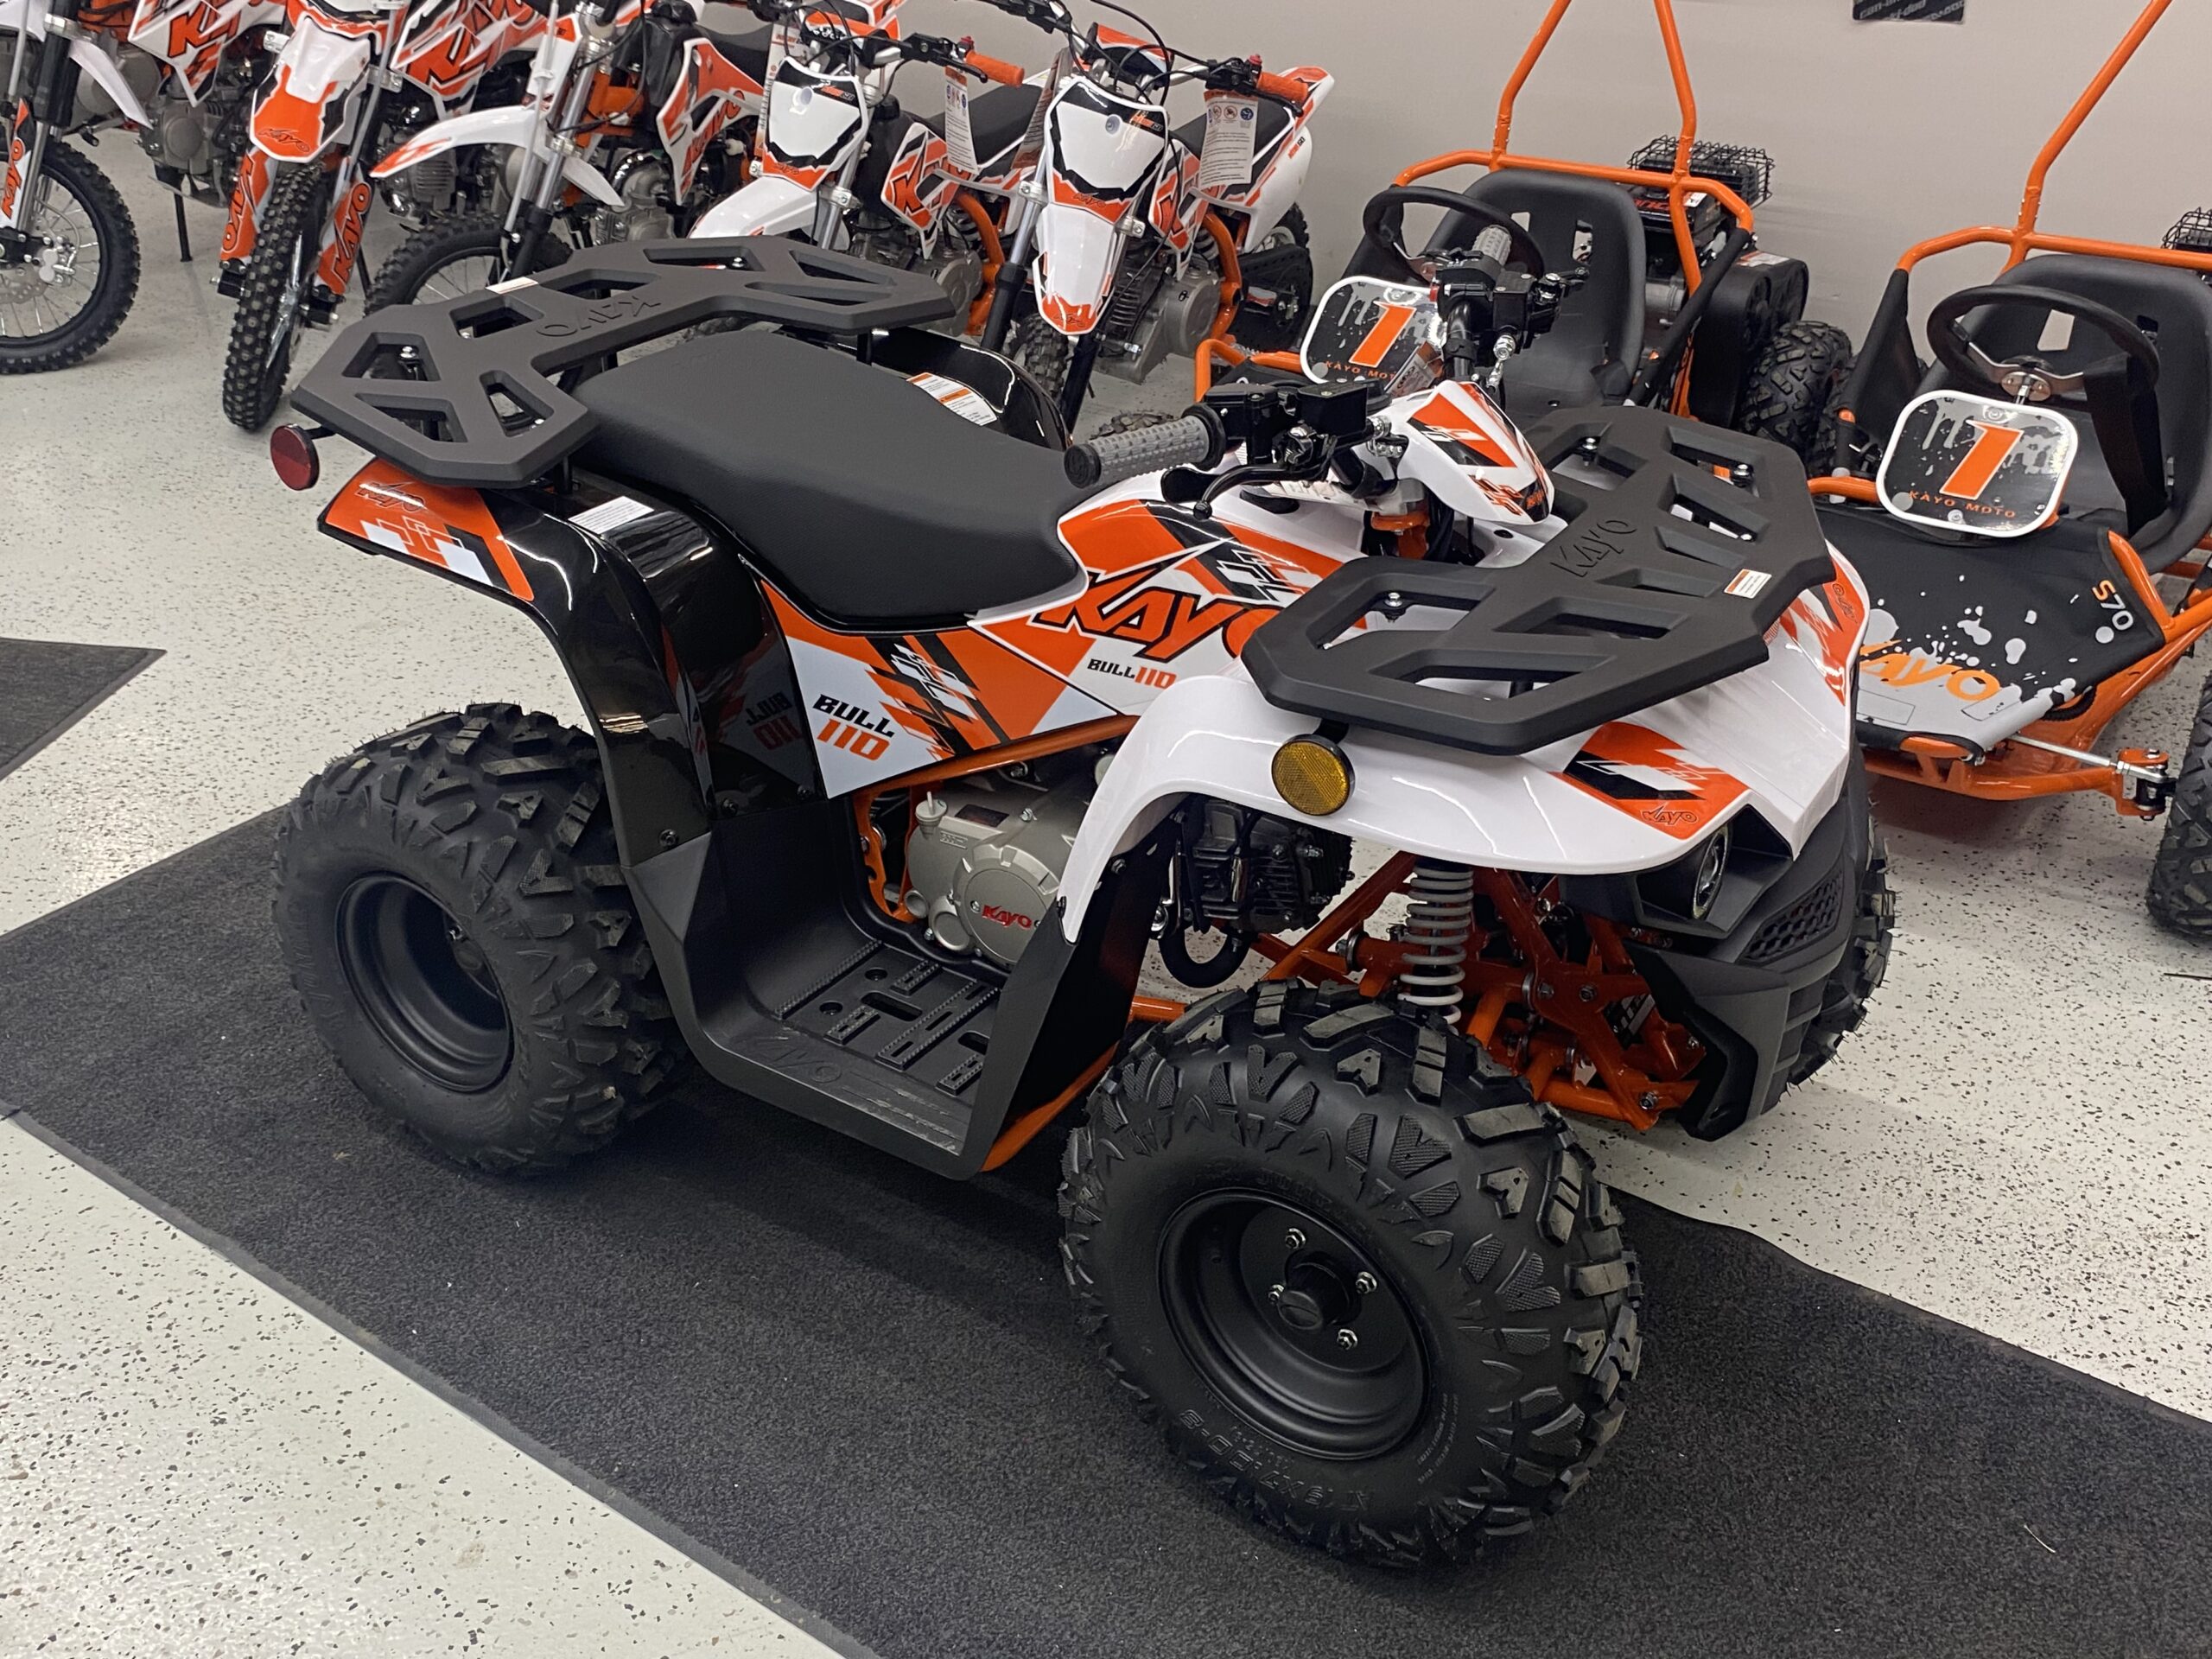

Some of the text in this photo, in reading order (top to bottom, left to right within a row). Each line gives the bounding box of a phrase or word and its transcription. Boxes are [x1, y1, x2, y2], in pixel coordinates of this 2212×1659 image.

[332, 182, 372, 283] KAYO
[536, 296, 661, 337] KAYO
[1325, 360, 1397, 380] KAYO MOT
[1908, 489, 2016, 518] KAYO MOTO
[1551, 519, 1637, 577] KAYO
[2092, 580, 2134, 631] S70
[812, 694, 895, 738] BULL
[817, 718, 890, 760] 110
[1641, 803, 1699, 826] KAYO
[982, 905, 1033, 930] KAYO
